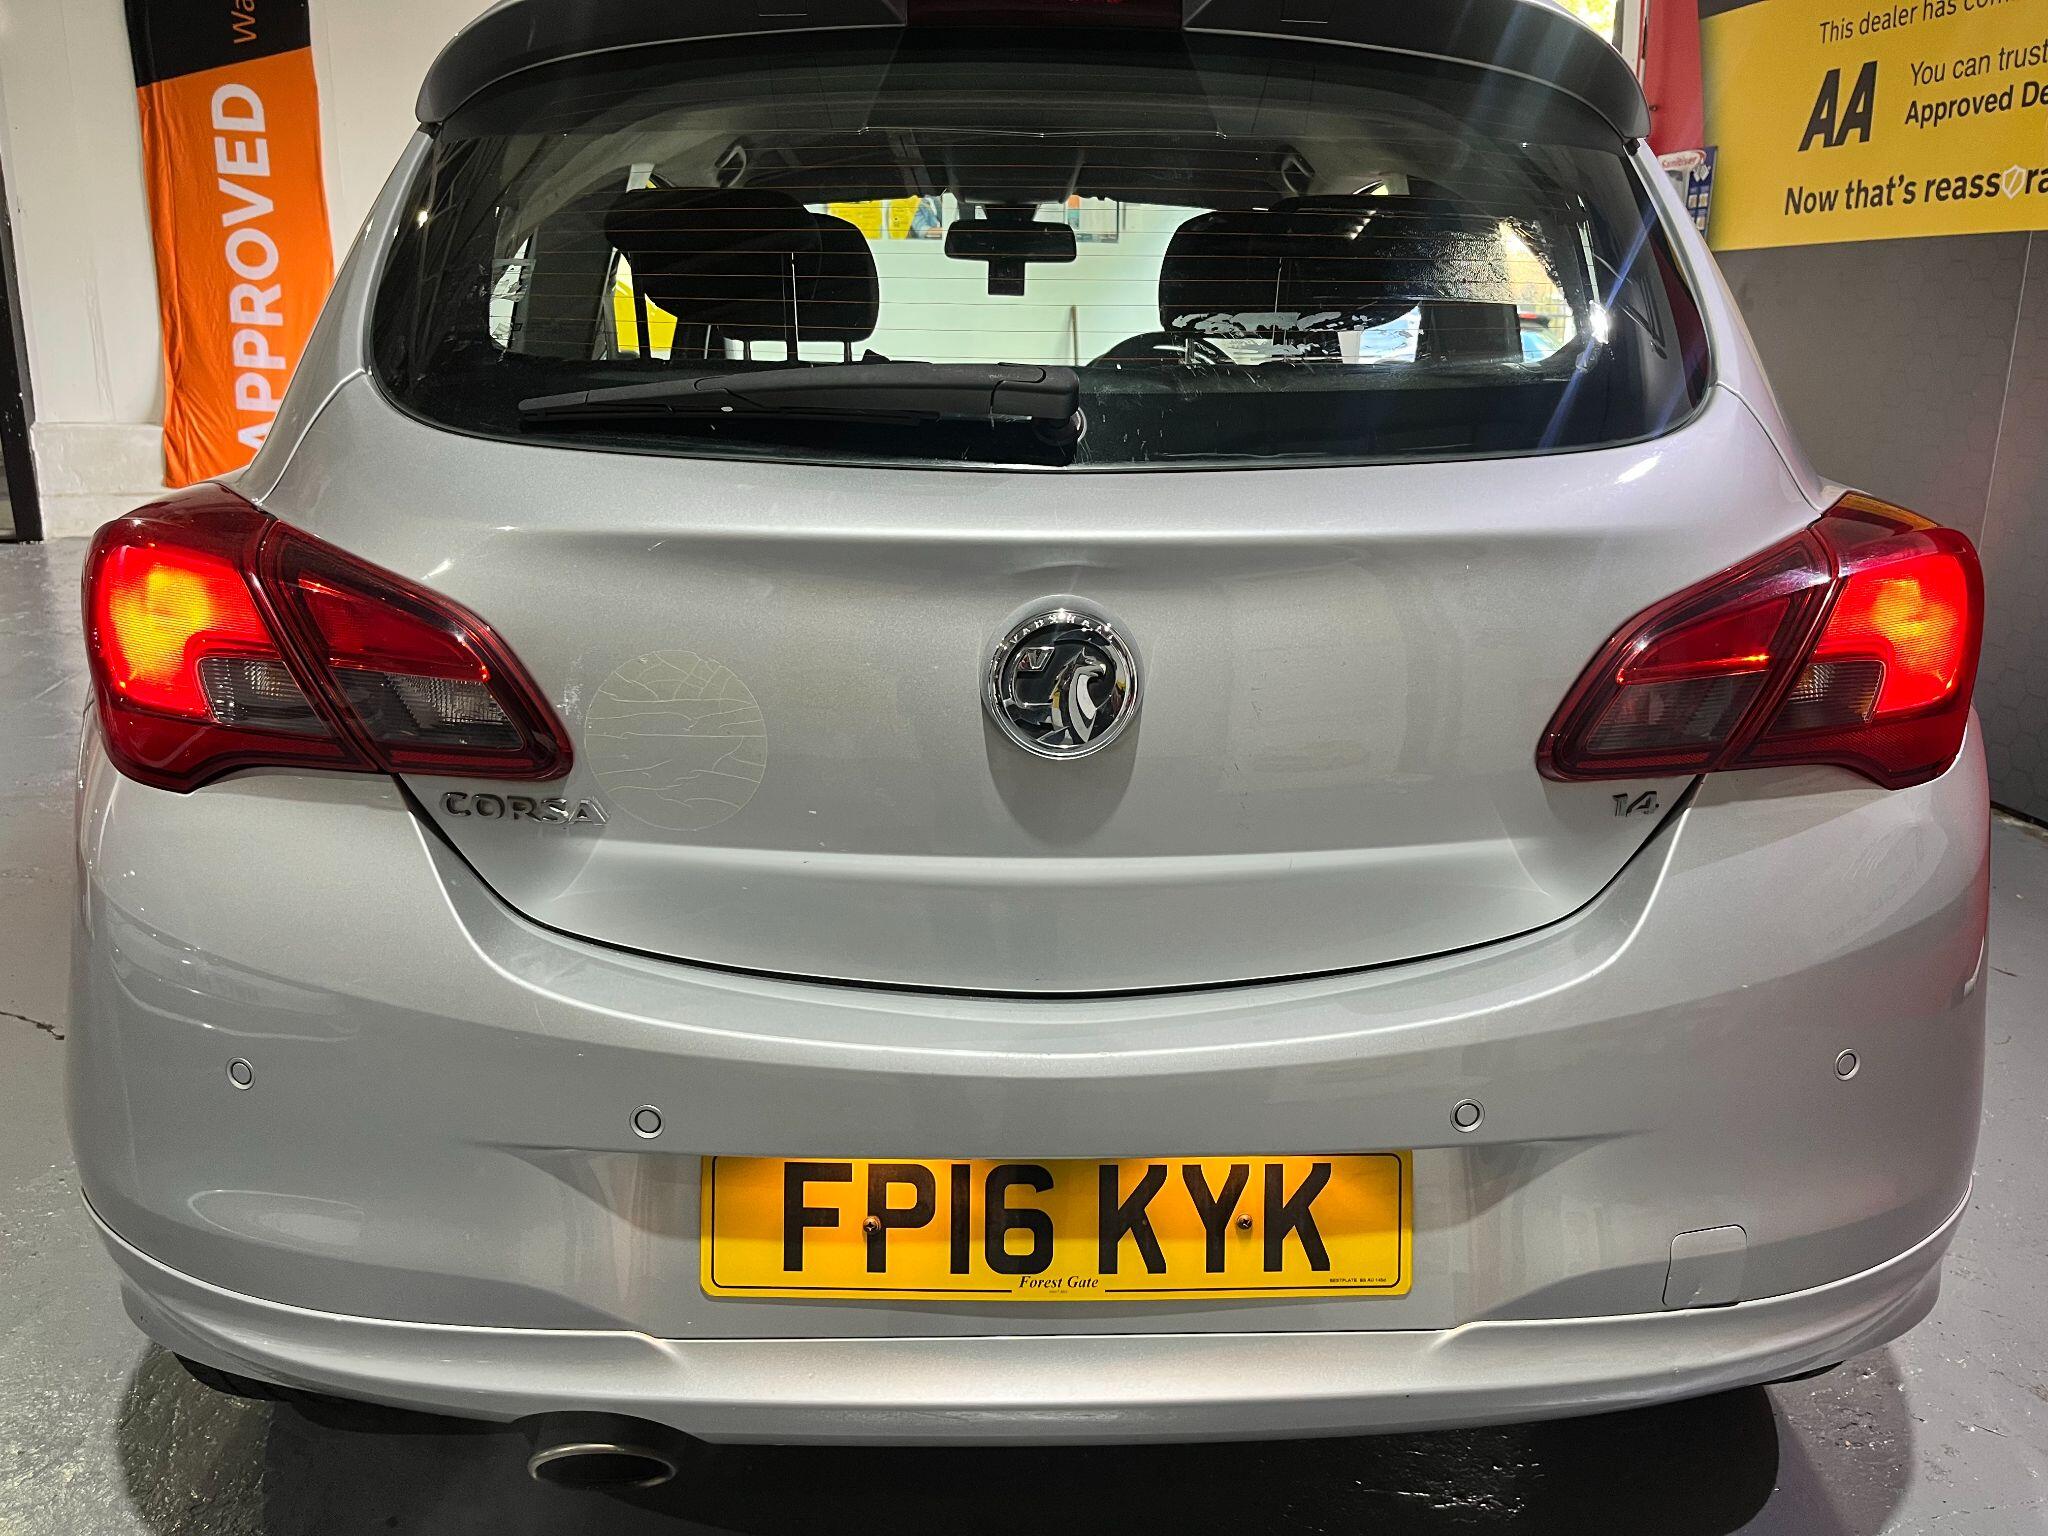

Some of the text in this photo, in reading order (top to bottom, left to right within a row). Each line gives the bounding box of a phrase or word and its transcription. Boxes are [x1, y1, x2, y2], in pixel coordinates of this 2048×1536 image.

[1820, 18, 1853, 44] This
[1859, 5, 1918, 36] dealer
[1923, 0, 1957, 21] has
[1911, 38, 2048, 86] You can trust
[1797, 60, 1878, 152] AA
[1904, 84, 2015, 129] Approved
[1784, 186, 1840, 216] Now
[1845, 174, 1917, 210] that's
[211, 82, 287, 457] APPROVED
[440, 791, 612, 826] CORSA
[783, 1161, 1333, 1275] FP16 KYK
[1019, 1275, 1099, 1289] Forest Gate
